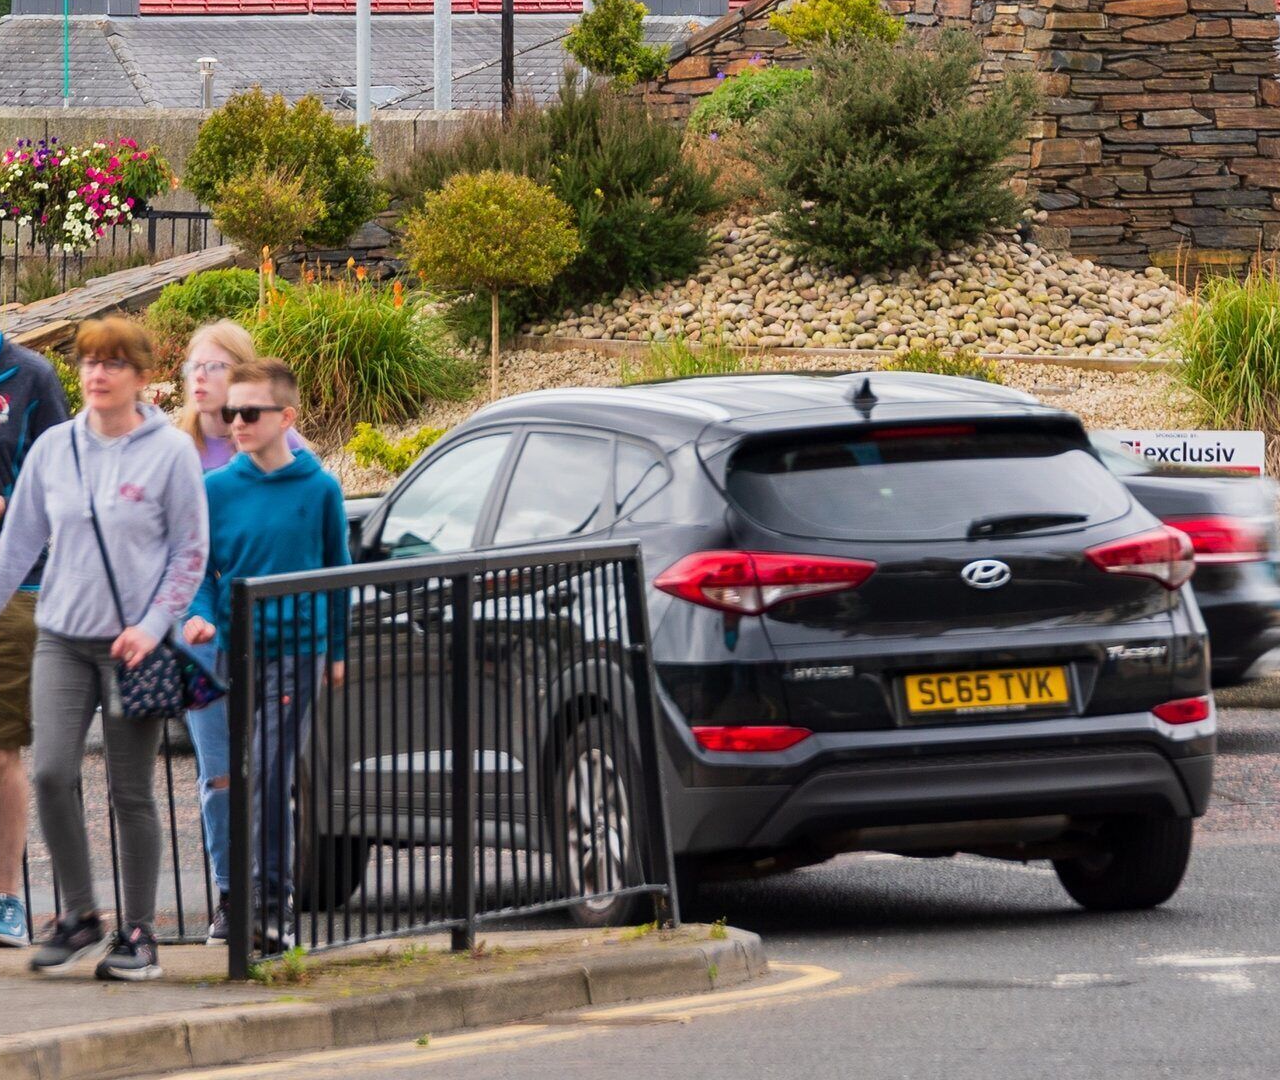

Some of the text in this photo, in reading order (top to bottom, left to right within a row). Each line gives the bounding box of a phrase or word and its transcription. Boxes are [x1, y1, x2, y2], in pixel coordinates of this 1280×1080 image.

[1144, 441, 1235, 463] exclusiv
[918, 670, 1053, 705] SC65 TVK
